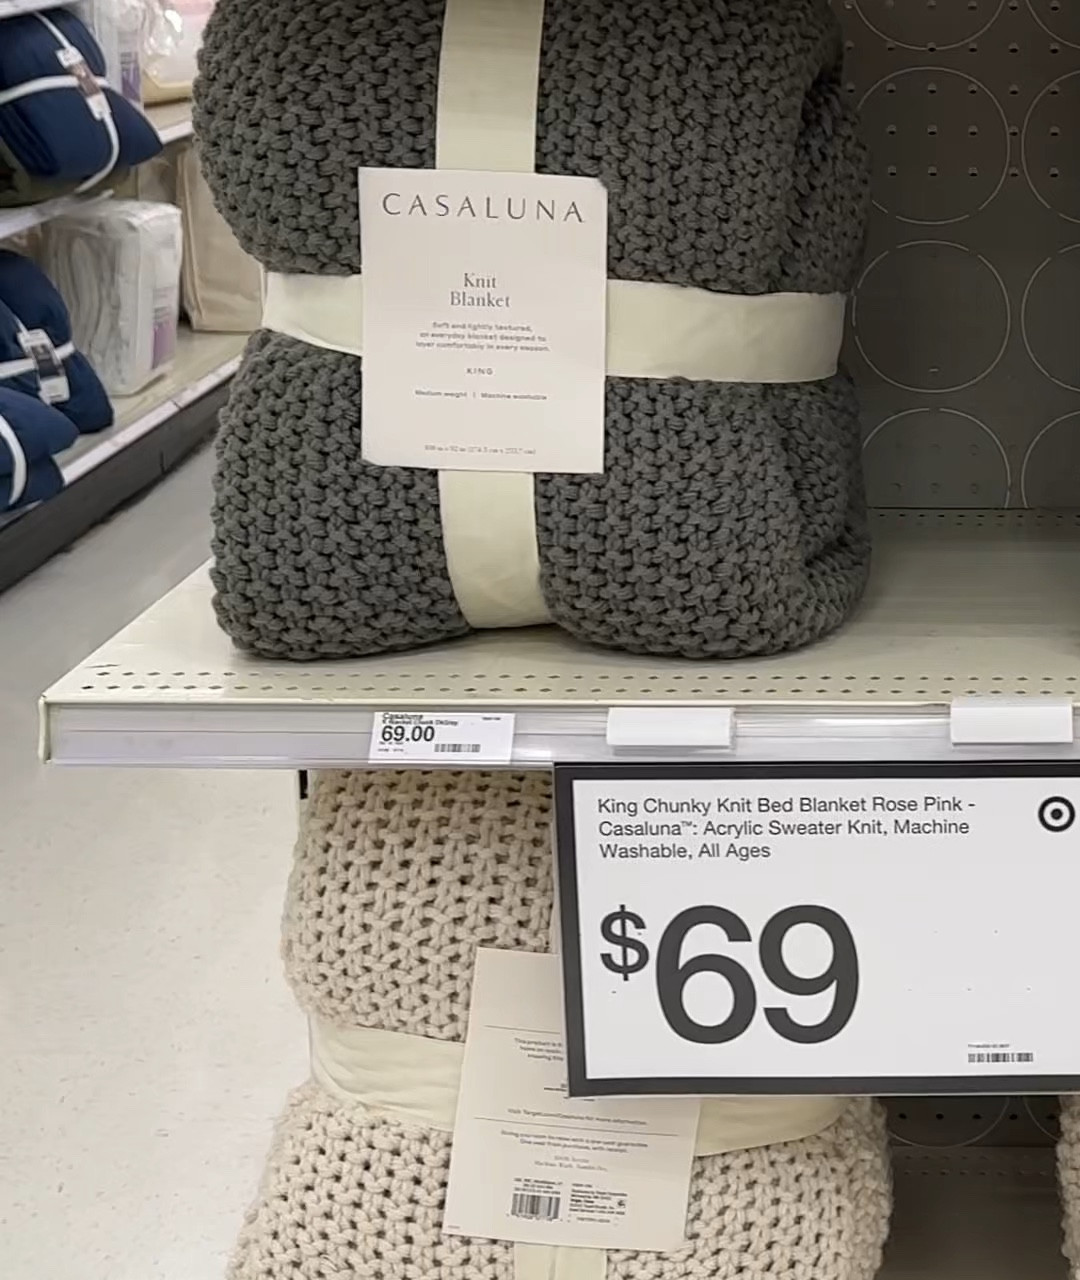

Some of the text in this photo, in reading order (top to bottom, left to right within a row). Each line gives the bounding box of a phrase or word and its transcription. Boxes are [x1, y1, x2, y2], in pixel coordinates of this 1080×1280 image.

[382, 192, 585, 222] CASALUNA
[464, 273, 496, 288] Knit
[450, 291, 510, 307] Blanket
[381, 726, 435, 742] 69.00
[598, 798, 638, 817] King
[643, 797, 711, 816] Chunky
[717, 797, 752, 813] Knit
[758, 797, 793, 813] Bed
[800, 797, 866, 812] Blanket
[872, 796, 918, 811] Rose
[924, 796, 963, 811] Pink
[703, 820, 763, 839] Acrylic
[768, 820, 842, 835] Sweater
[848, 819, 888, 836] Knit,
[894, 819, 970, 834] Machine
[600, 842, 771, 862] Washable, All Ages
